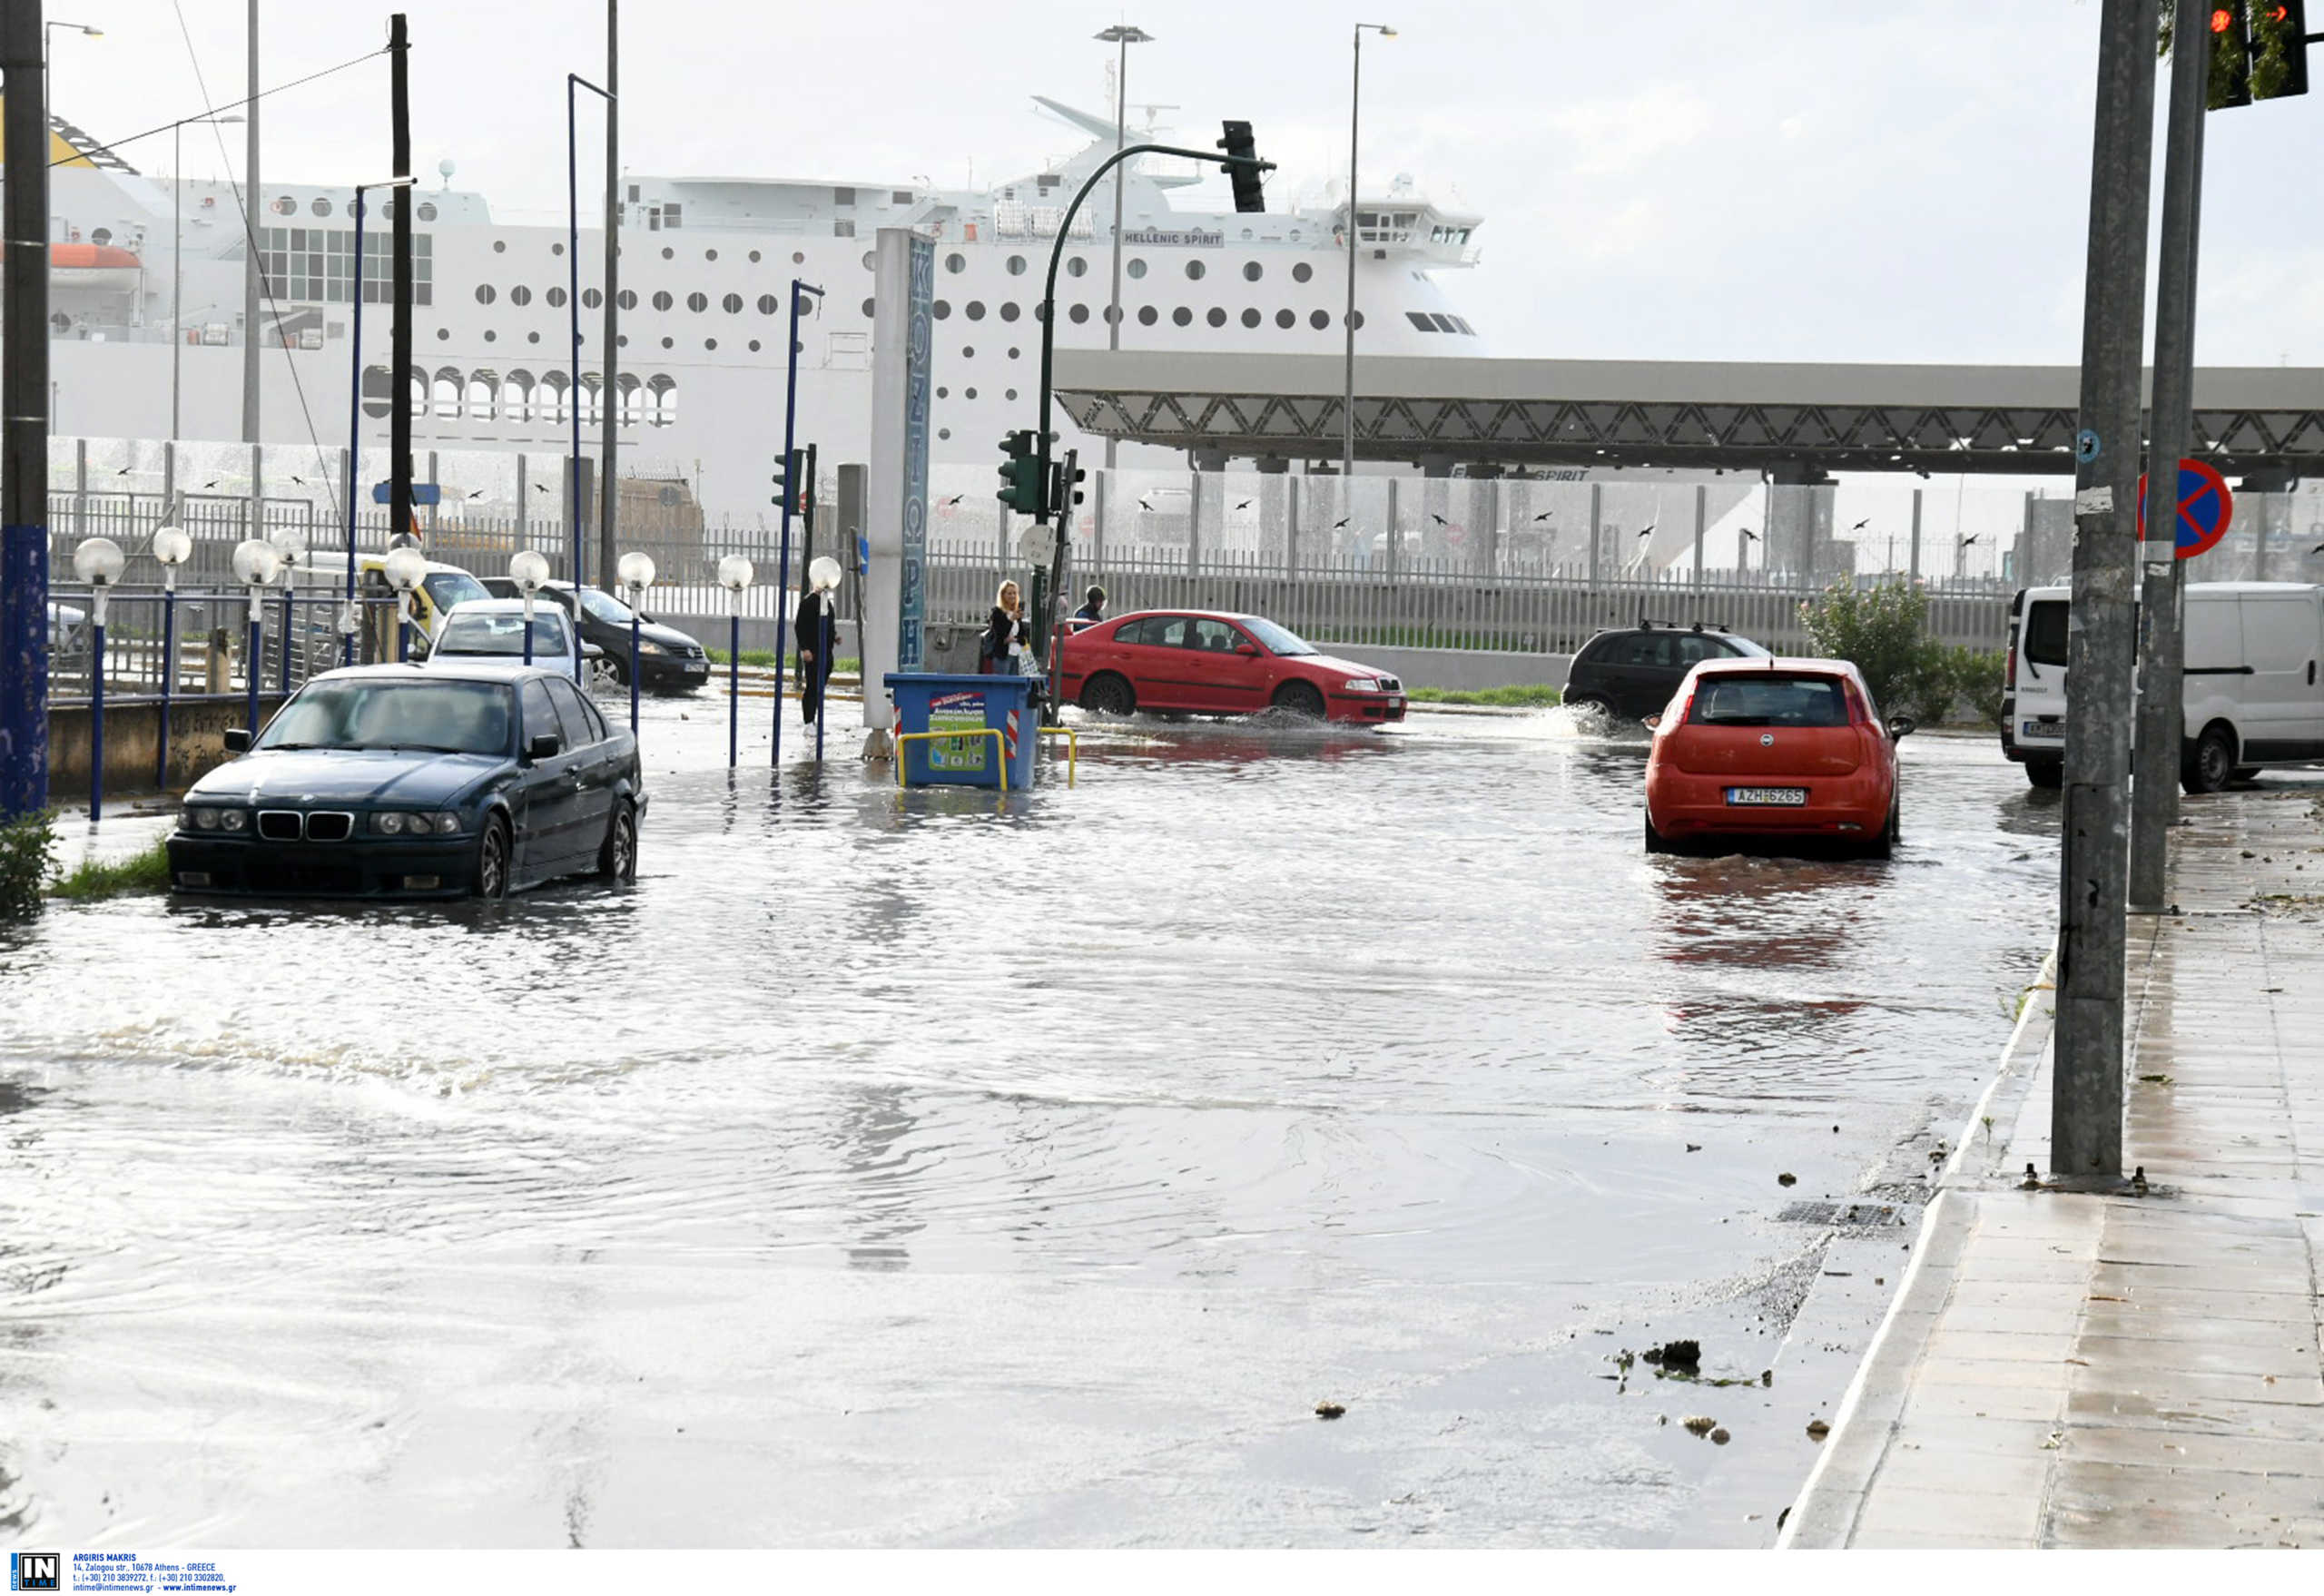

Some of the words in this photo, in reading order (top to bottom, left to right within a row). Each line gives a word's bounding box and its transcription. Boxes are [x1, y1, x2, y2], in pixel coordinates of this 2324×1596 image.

[1125, 232, 1179, 244] HELLENIC
[1184, 234, 1221, 245] SPIRIT
[1535, 469, 1590, 481] SPIRIT
